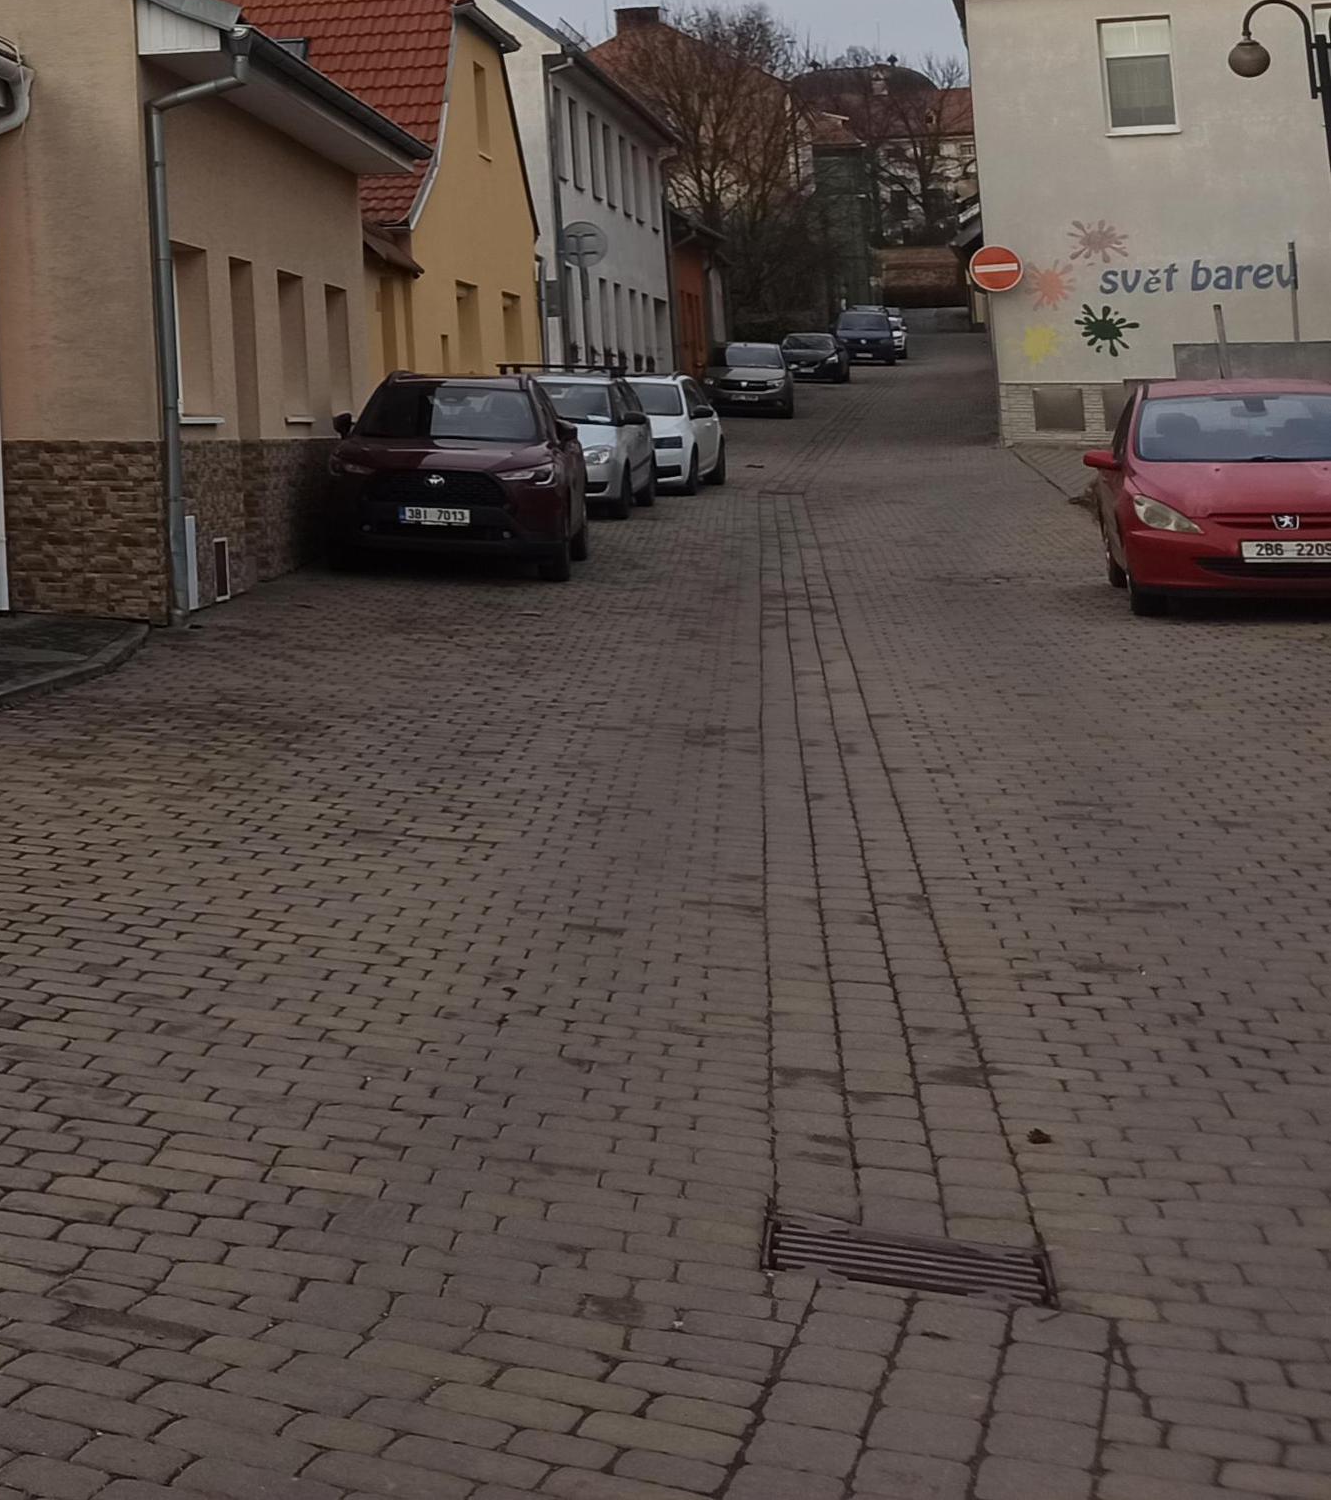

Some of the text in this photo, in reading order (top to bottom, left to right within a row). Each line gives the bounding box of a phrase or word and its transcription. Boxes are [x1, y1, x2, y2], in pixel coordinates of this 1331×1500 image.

[1099, 259, 1298, 295] svět barev
[437, 509, 465, 521] 7013
[1255, 543, 1284, 556] 2B6
